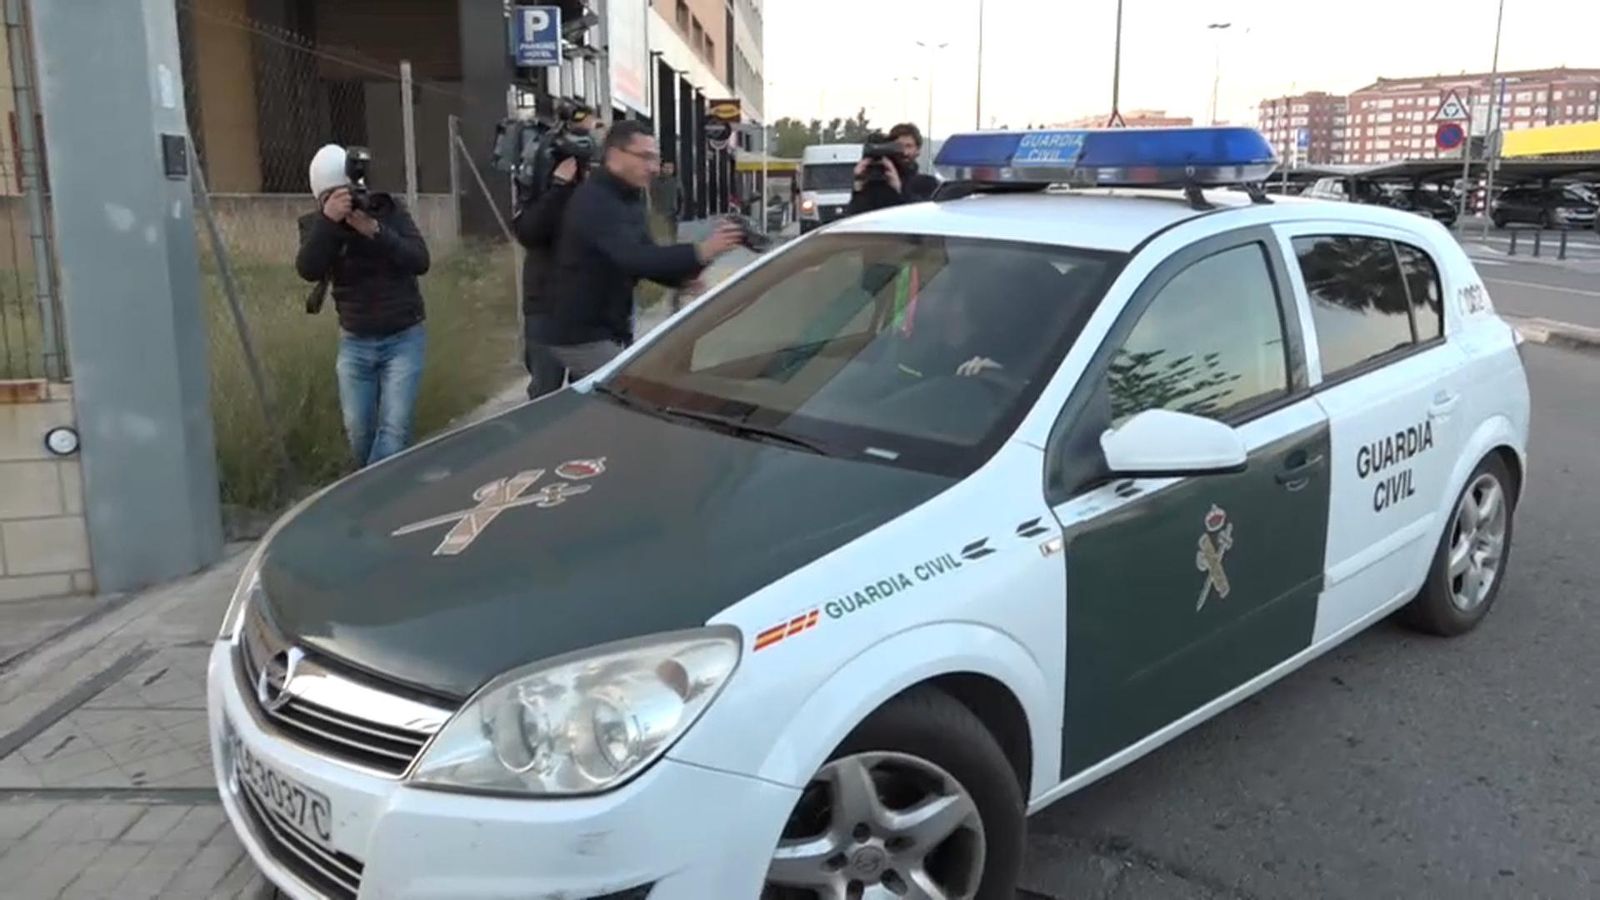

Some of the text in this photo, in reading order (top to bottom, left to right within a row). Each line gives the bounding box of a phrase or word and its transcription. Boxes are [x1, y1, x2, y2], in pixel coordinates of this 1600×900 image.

[524, 10, 549, 42] P
[1020, 132, 1084, 148] GUARDIA
[1028, 148, 1061, 161] CIVIL
[1356, 420, 1434, 479] GUARDIA
[1373, 469, 1416, 512] CIVIL
[824, 552, 963, 620] GUARDIA CIVIL
